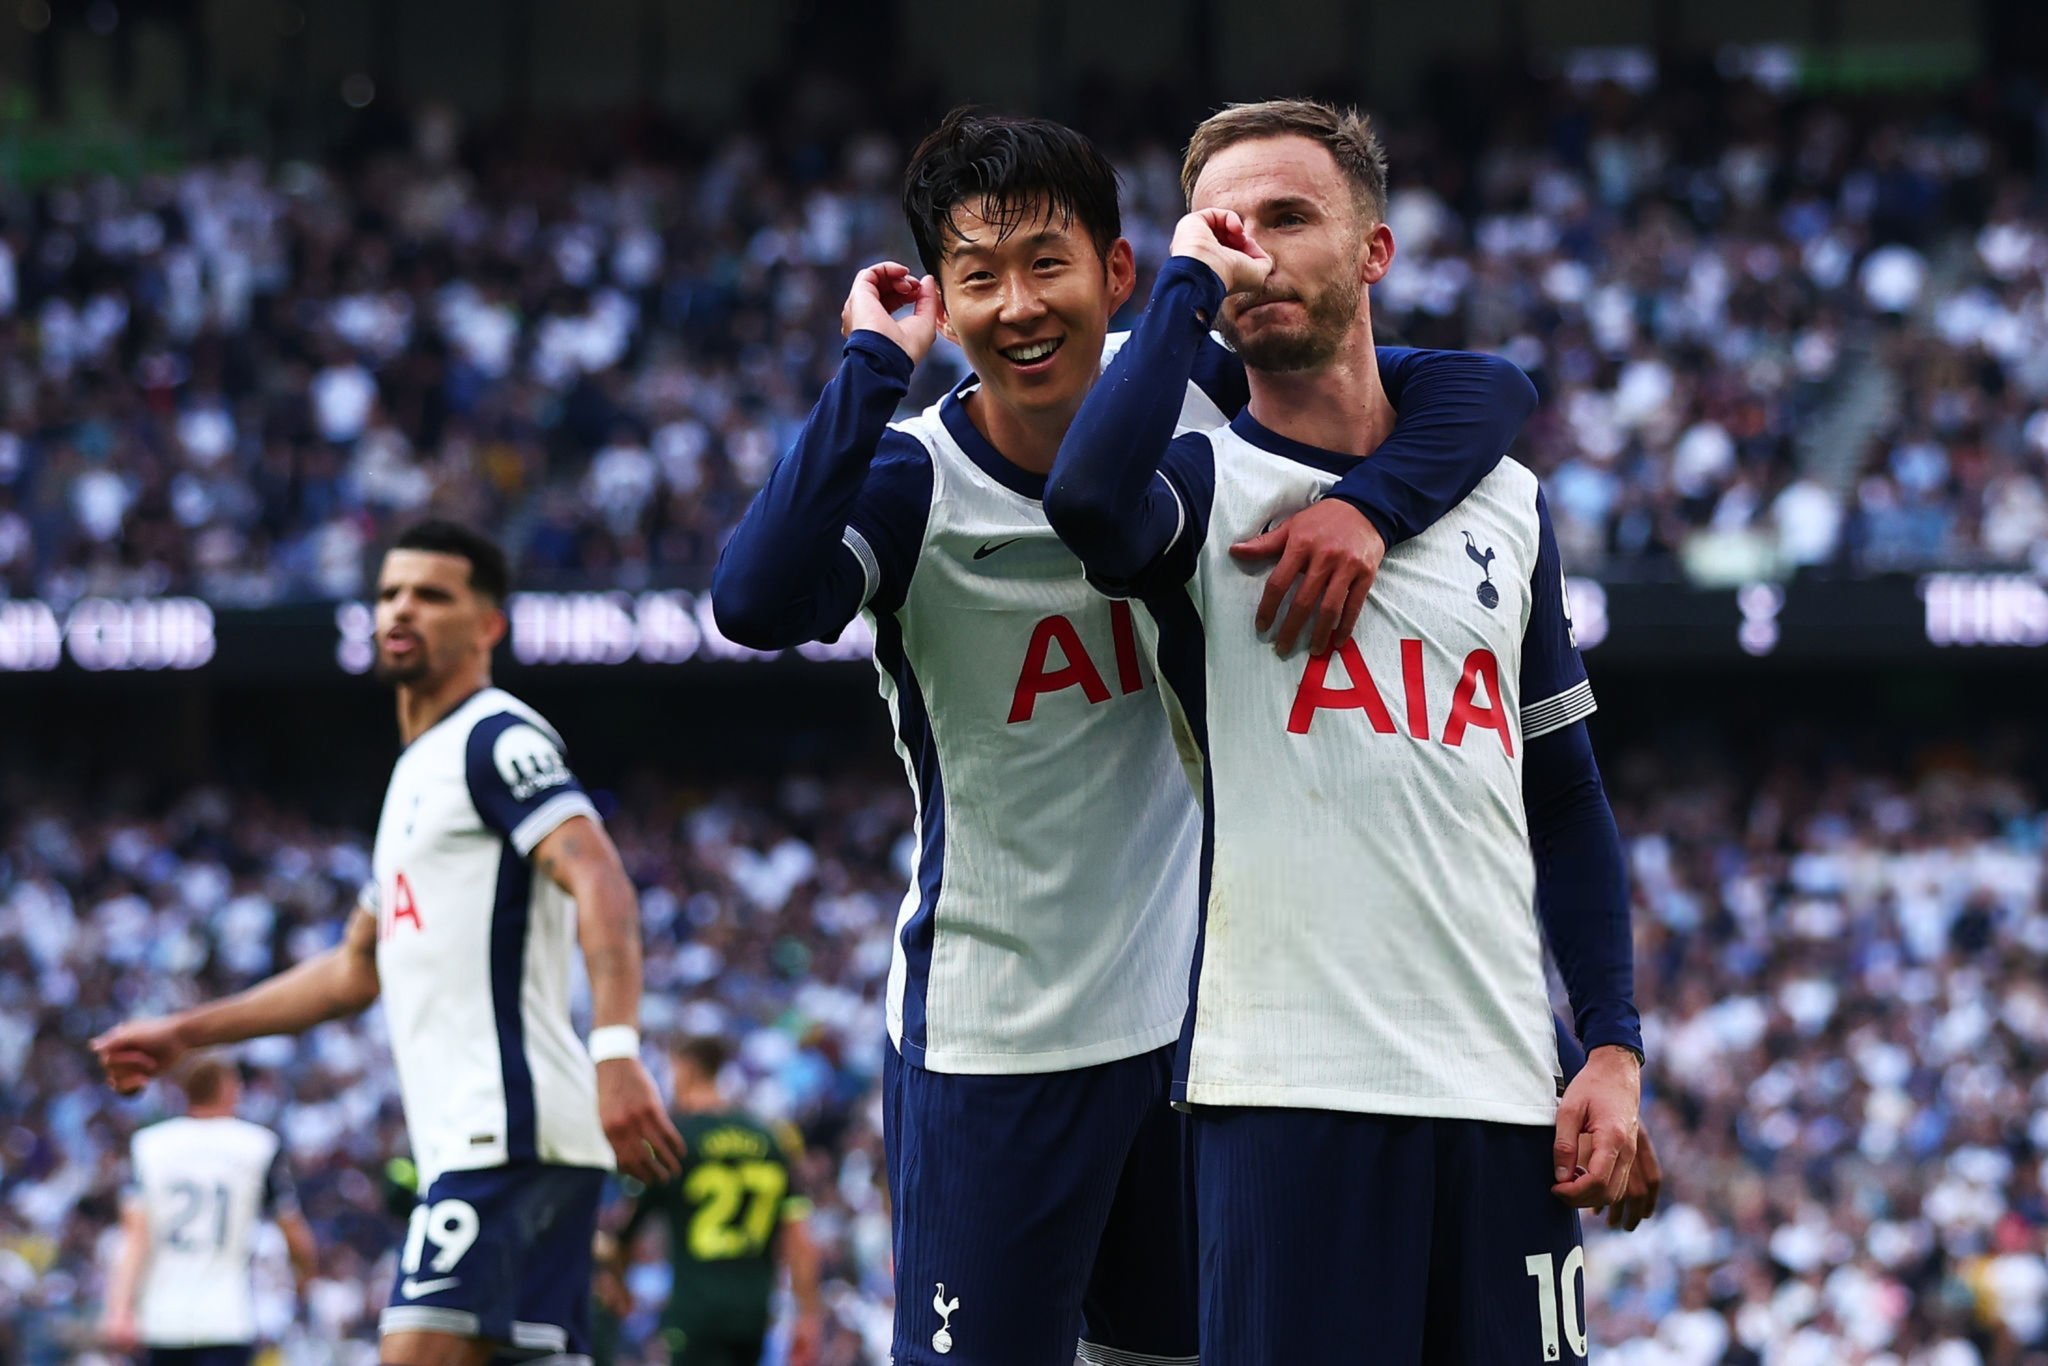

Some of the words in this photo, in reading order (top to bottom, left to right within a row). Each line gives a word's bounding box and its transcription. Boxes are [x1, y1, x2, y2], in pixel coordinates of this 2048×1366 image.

[1007, 599, 1156, 723] AI
[1287, 630, 1514, 758] AIA
[163, 1178, 229, 1251] 21
[402, 1199, 480, 1274] 19
[685, 1161, 787, 1258] 27
[1525, 1245, 1587, 1362] 10
